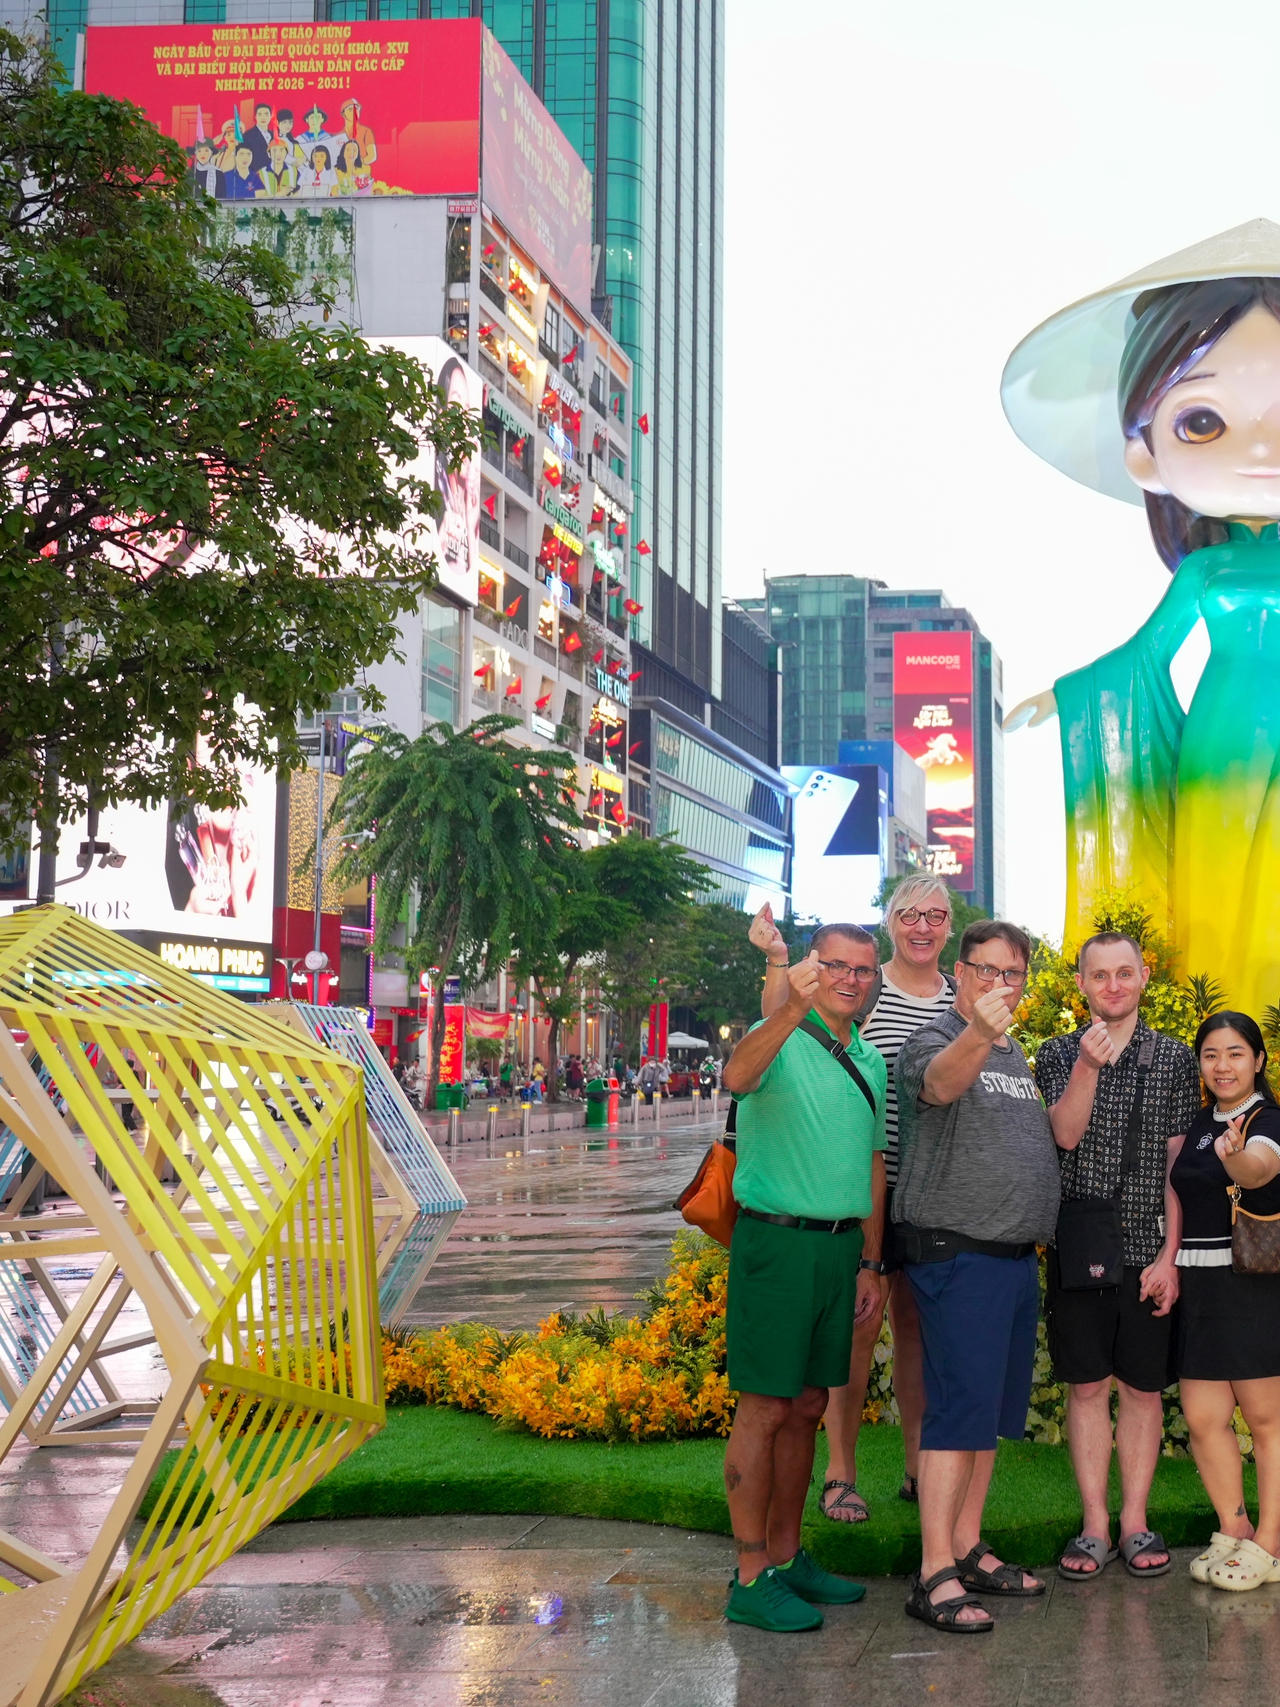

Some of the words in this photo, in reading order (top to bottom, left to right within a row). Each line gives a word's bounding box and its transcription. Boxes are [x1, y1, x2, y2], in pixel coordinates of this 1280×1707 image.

[212, 26, 250, 41] NHIỆT
[251, 26, 278, 41] LIỆT
[281, 24, 313, 39] CHÀO
[316, 24, 351, 38] MỪNG
[153, 44, 185, 58] NGÀY
[187, 41, 211, 57] BẦU
[214, 43, 230, 57] CỬ
[233, 43, 254, 60] ĐẠI
[256, 41, 284, 57] BIỂU
[287, 40, 320, 59] QUỐC
[322, 42, 345, 58] HỘI
[347, 39, 381, 54] KHÓA
[386, 42, 409, 55] XVI
[157, 61, 172, 75] VÀ
[174, 62, 195, 78] ĐẠI
[198, 58, 226, 75] BIỂU
[229, 59, 252, 77] HỘI
[254, 57, 288, 74] ĐỒNG
[290, 58, 324, 73] NHÂN
[326, 57, 351, 72] DÂN
[354, 57, 378, 71] CÁC
[381, 54, 405, 71] CẤP
[215, 75, 256, 93] NHIỆM
[258, 76, 274, 91] KỲ
[277, 77, 305, 90] 2026
[317, 76, 351, 90] 2031!
[514, 82, 544, 149] Mừng
[514, 118, 544, 184] Mừng
[544, 165, 570, 213] Xuân
[537, 213, 551, 238] KIM
[545, 490, 583, 538] Kangaroo
[906, 655, 960, 665] MANCODE
[596, 668, 612, 696] THE
[613, 679, 631, 707] ONE
[160, 943, 220, 973] HOANG
[221, 949, 265, 976] PHUC
